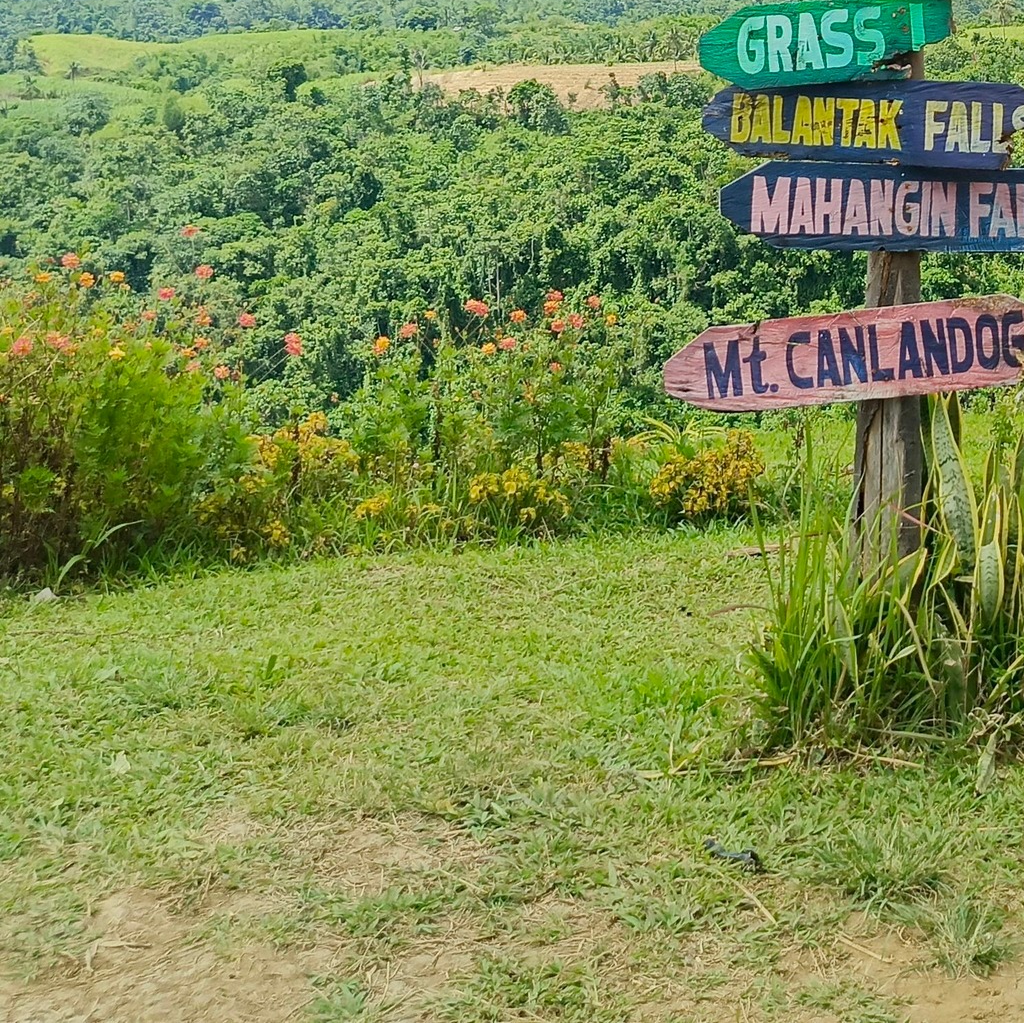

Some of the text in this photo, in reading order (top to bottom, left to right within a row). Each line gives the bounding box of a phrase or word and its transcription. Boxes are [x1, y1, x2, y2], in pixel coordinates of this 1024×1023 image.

[737, 5, 886, 75] GRASS
[729, 93, 903, 151] BALANTAK
[750, 175, 958, 238] MAHANGIN
[703, 337, 779, 400] Mt.
